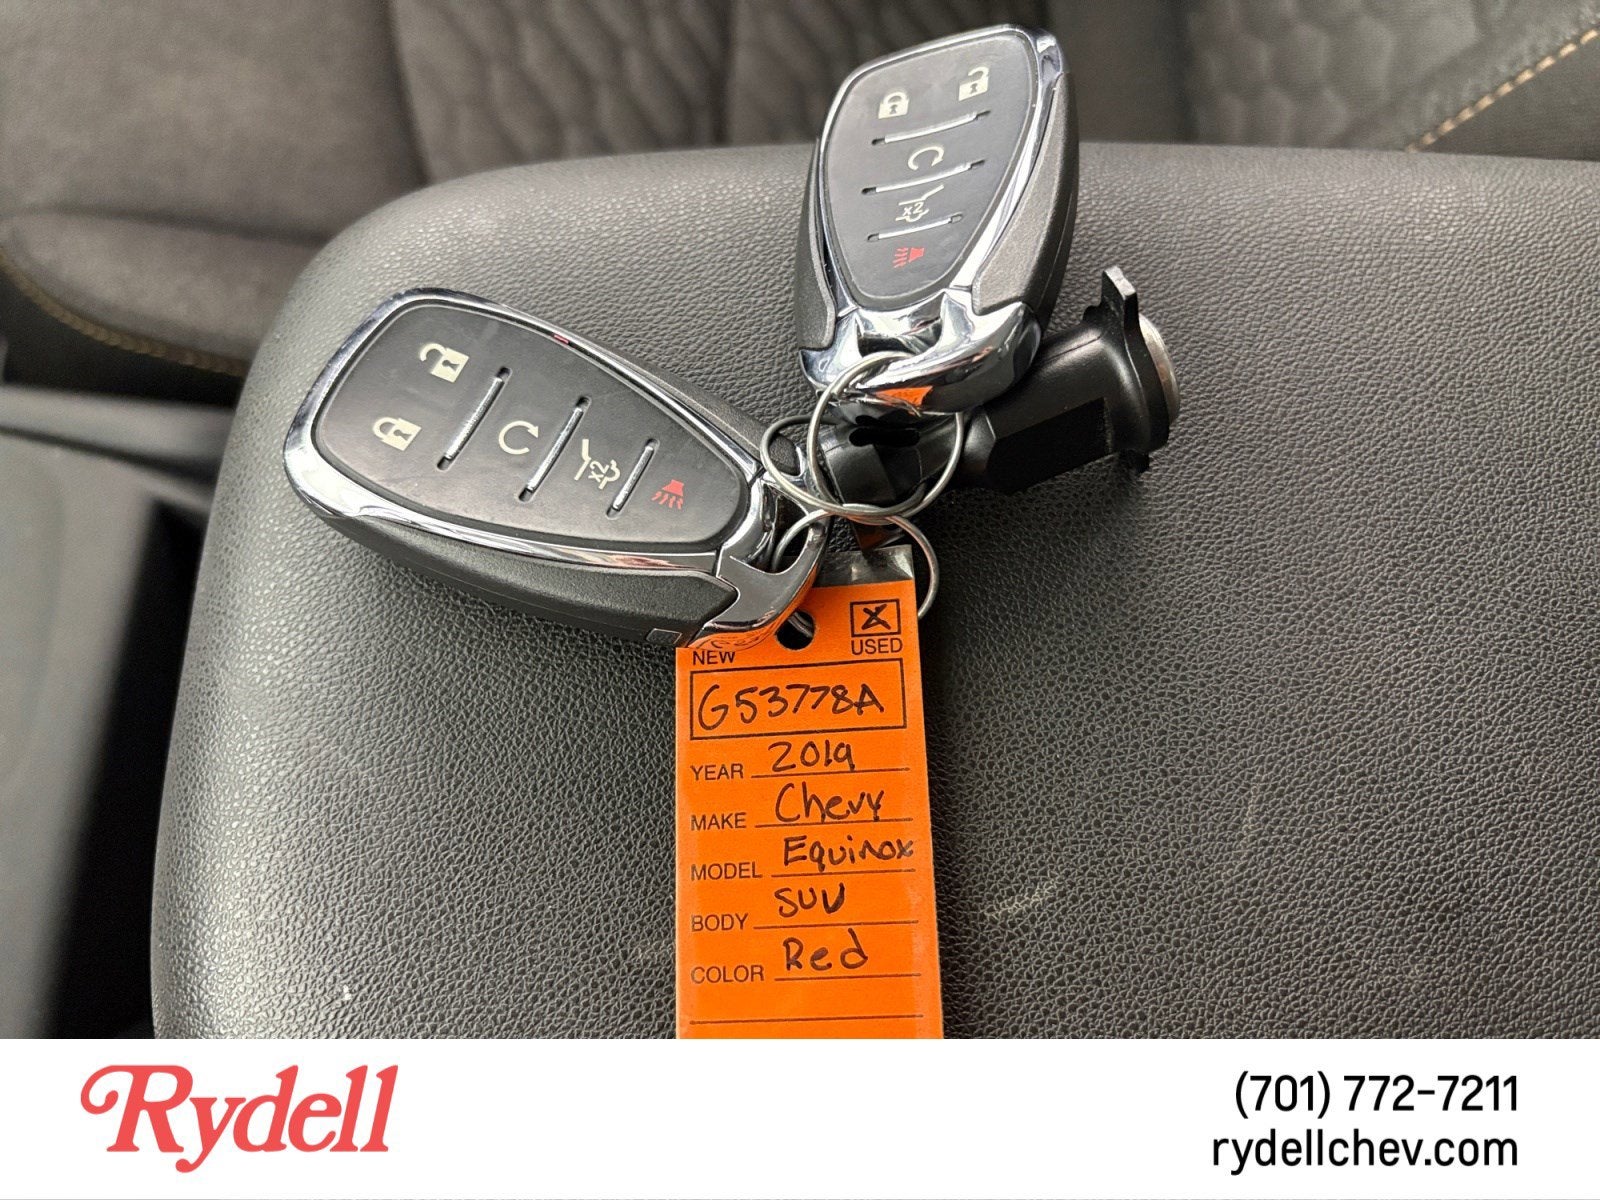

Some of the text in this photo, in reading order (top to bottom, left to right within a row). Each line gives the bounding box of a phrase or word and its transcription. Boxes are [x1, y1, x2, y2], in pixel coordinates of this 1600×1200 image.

[850, 637, 904, 656] USED
[692, 650, 736, 665] NEW
[697, 683, 885, 731] G53778A
[767, 739, 856, 773] 2019
[690, 763, 744, 781] YEAR
[774, 782, 885, 823] Chevy
[690, 812, 747, 831] MAKE
[783, 834, 914, 872] Equinox
[690, 862, 763, 880] MODEL
[774, 882, 846, 917] SUV
[690, 912, 749, 932] BODY
[783, 928, 869, 970] Red
[690, 964, 764, 984] COLOR
